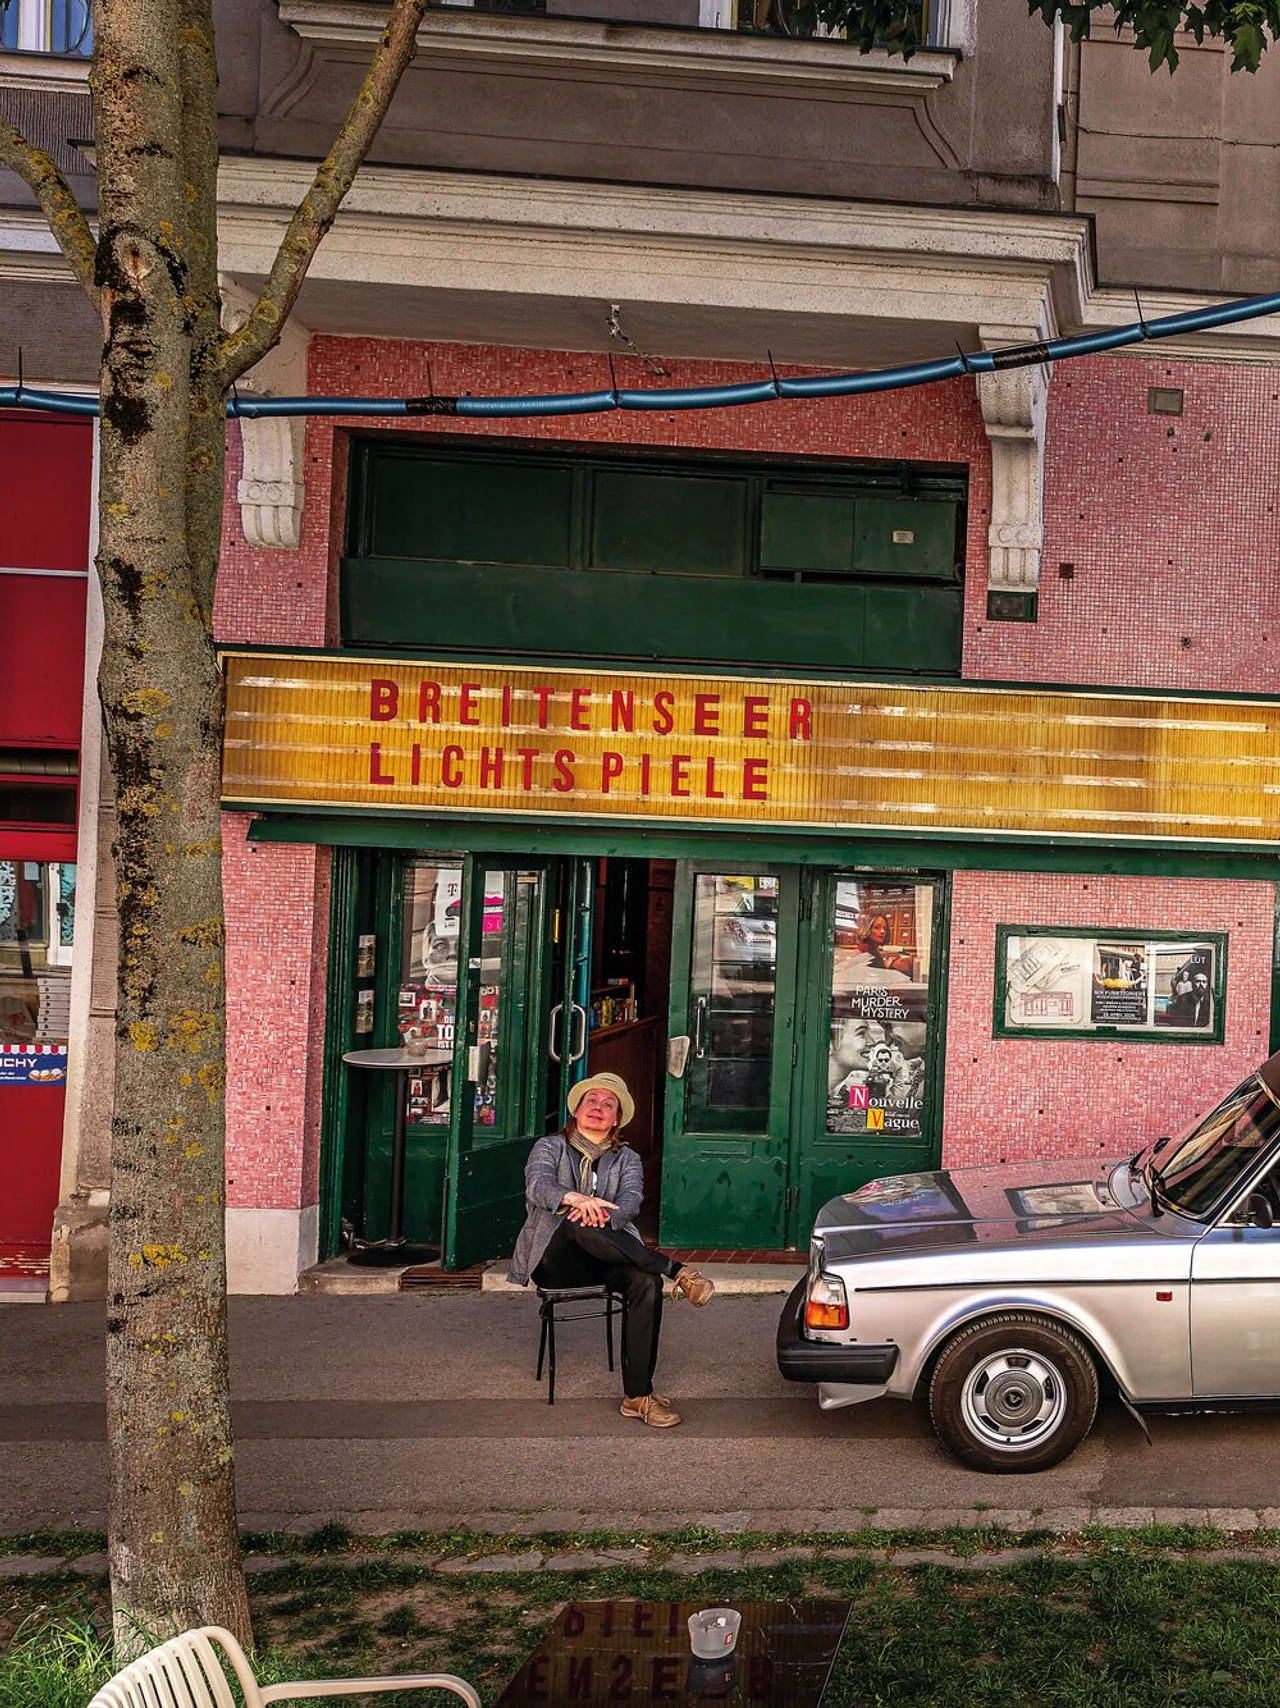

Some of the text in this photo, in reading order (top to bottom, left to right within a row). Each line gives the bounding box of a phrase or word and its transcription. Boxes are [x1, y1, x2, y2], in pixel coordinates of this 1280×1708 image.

[370, 678, 812, 740] BREITENSEER
[370, 742, 769, 800] LICHTSPIELE
[856, 986, 888, 997] PARIS
[851, 996, 902, 1009] MURDER
[861, 1008, 909, 1019] MYSTERY
[437, 1025, 454, 1040] TO
[852, 1088, 923, 1110] Nouvelle
[869, 1111, 920, 1129] Vague
